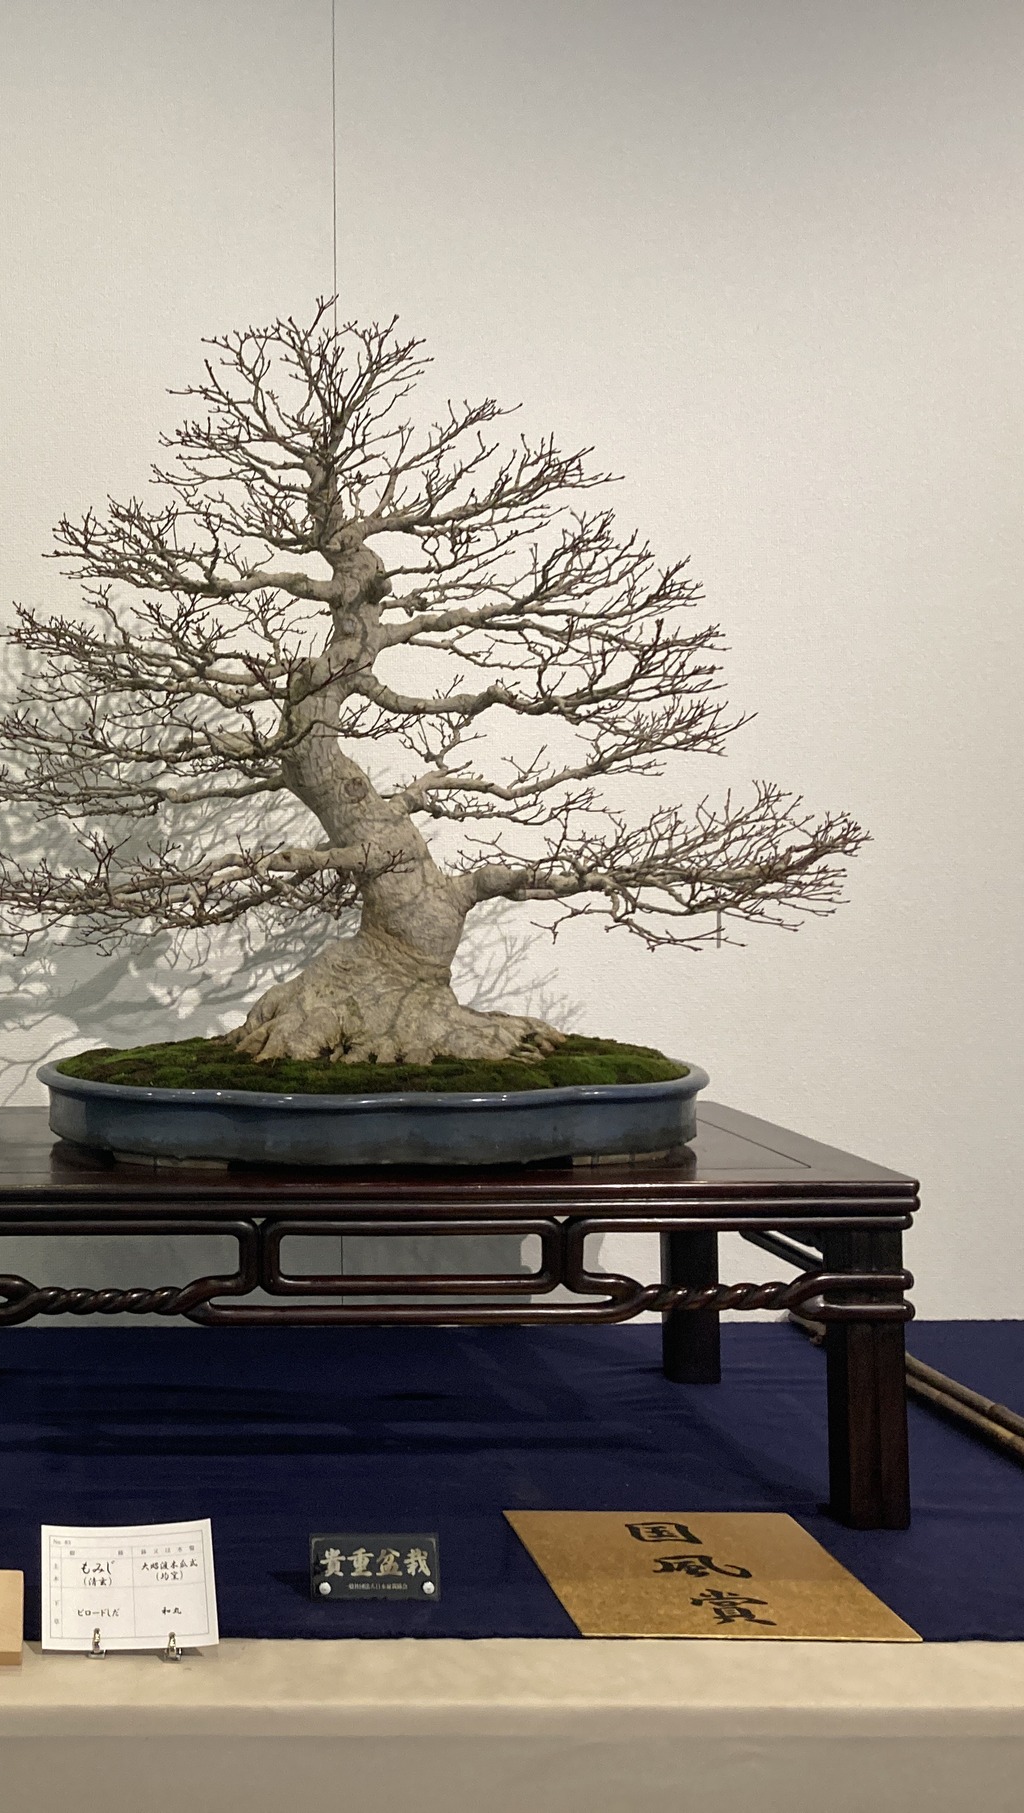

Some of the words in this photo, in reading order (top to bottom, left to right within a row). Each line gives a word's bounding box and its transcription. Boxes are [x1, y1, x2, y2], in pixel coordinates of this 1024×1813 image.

[81, 1560, 115, 1575] もみじ
[319, 1547, 432, 1577] 貴重盆栽
